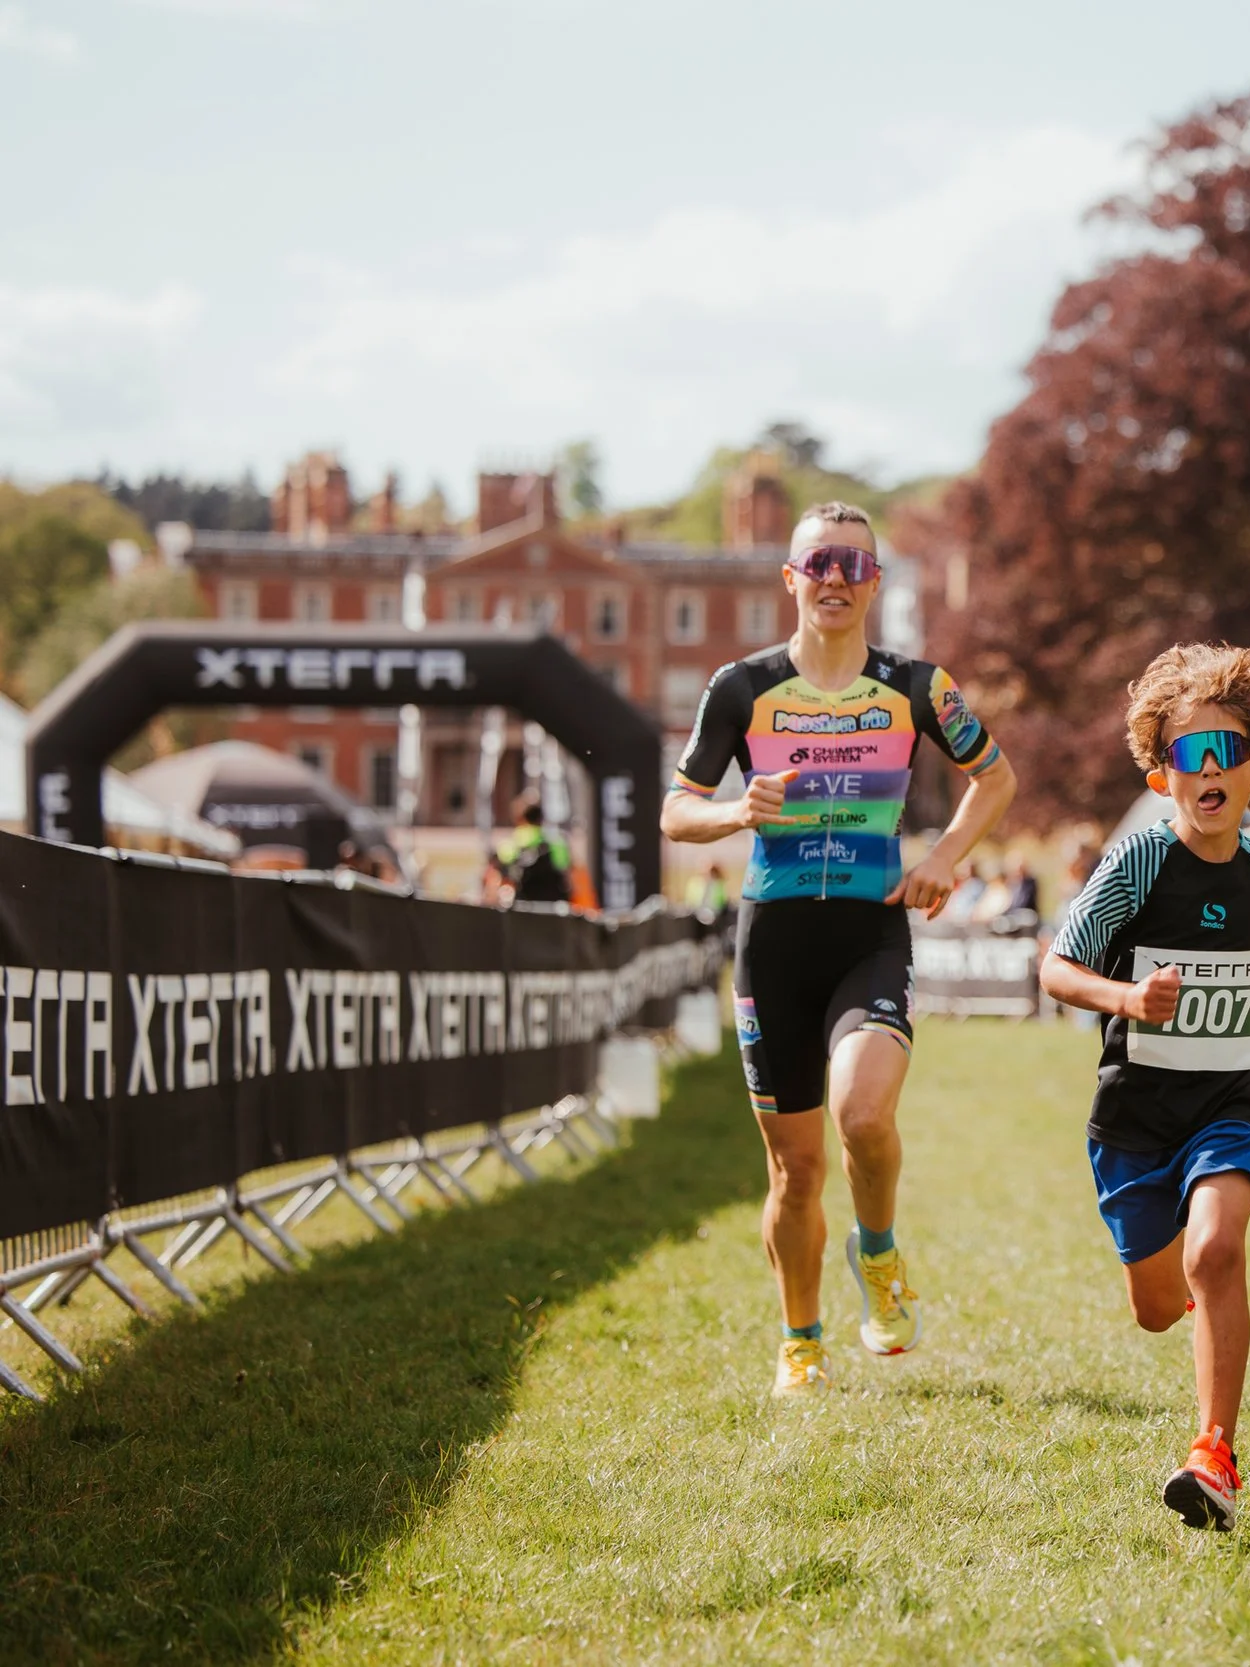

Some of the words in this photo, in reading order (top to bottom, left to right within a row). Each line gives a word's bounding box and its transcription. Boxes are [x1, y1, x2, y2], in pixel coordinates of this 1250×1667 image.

[197, 648, 465, 690] XTERRA
[813, 745, 878, 756] CHAMPION
[813, 756, 861, 764] SYSTEM
